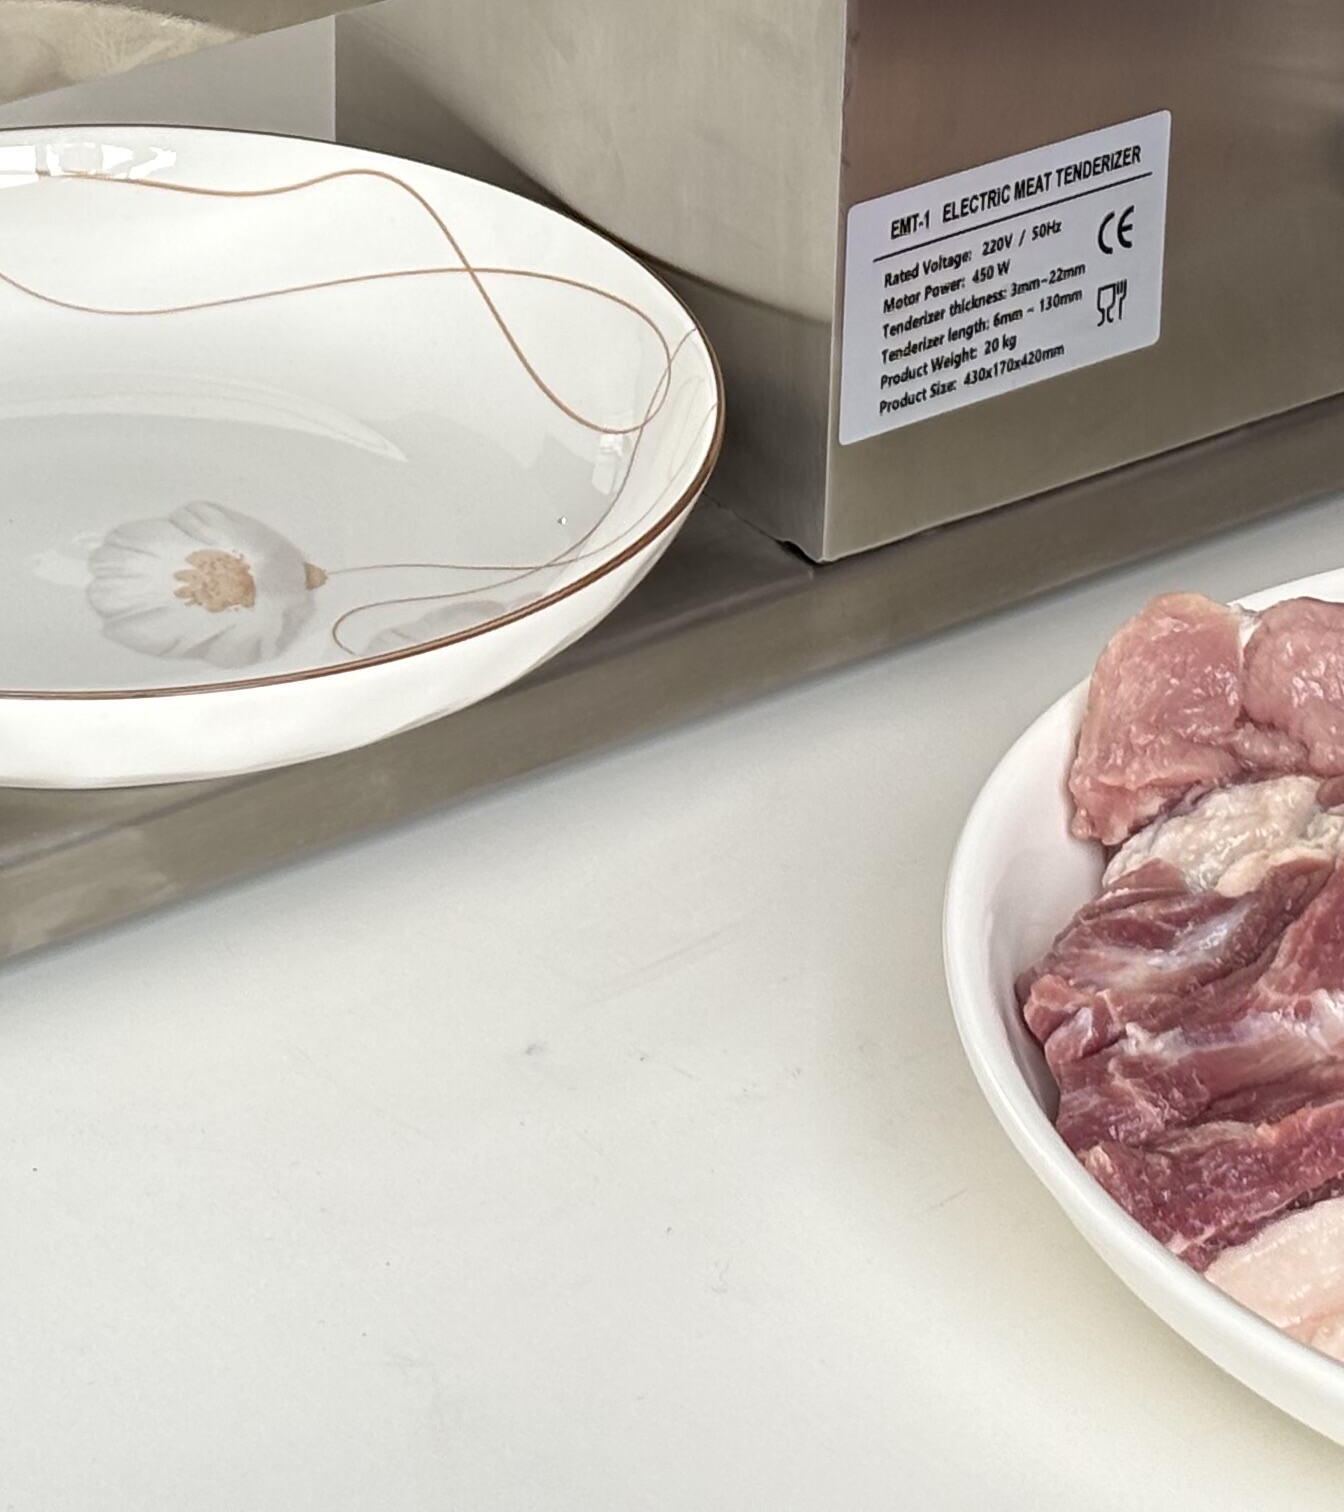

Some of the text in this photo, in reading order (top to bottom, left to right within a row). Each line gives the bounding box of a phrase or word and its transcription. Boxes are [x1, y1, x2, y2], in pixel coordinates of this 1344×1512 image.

[891, 145, 1142, 239] EMT-1 ELECTRIC MEAT TENDERIZER
[884, 219, 1062, 288] Rated Voltage: 220V / 50Hz
[1097, 205, 1135, 255] CE
[882, 308, 946, 339] Tenderizer
[949, 289, 1008, 317] thickness:
[883, 258, 1011, 314] Motor Power: 450 W
[881, 334, 944, 365] Tenderizer
[947, 318, 990, 342] length:
[993, 309, 1023, 327] 6mm
[1040, 289, 1083, 312] 130mm
[879, 344, 1065, 416] Product Size: 430x170x420mm
[880, 333, 1017, 390] Product Weight: 20 kg
